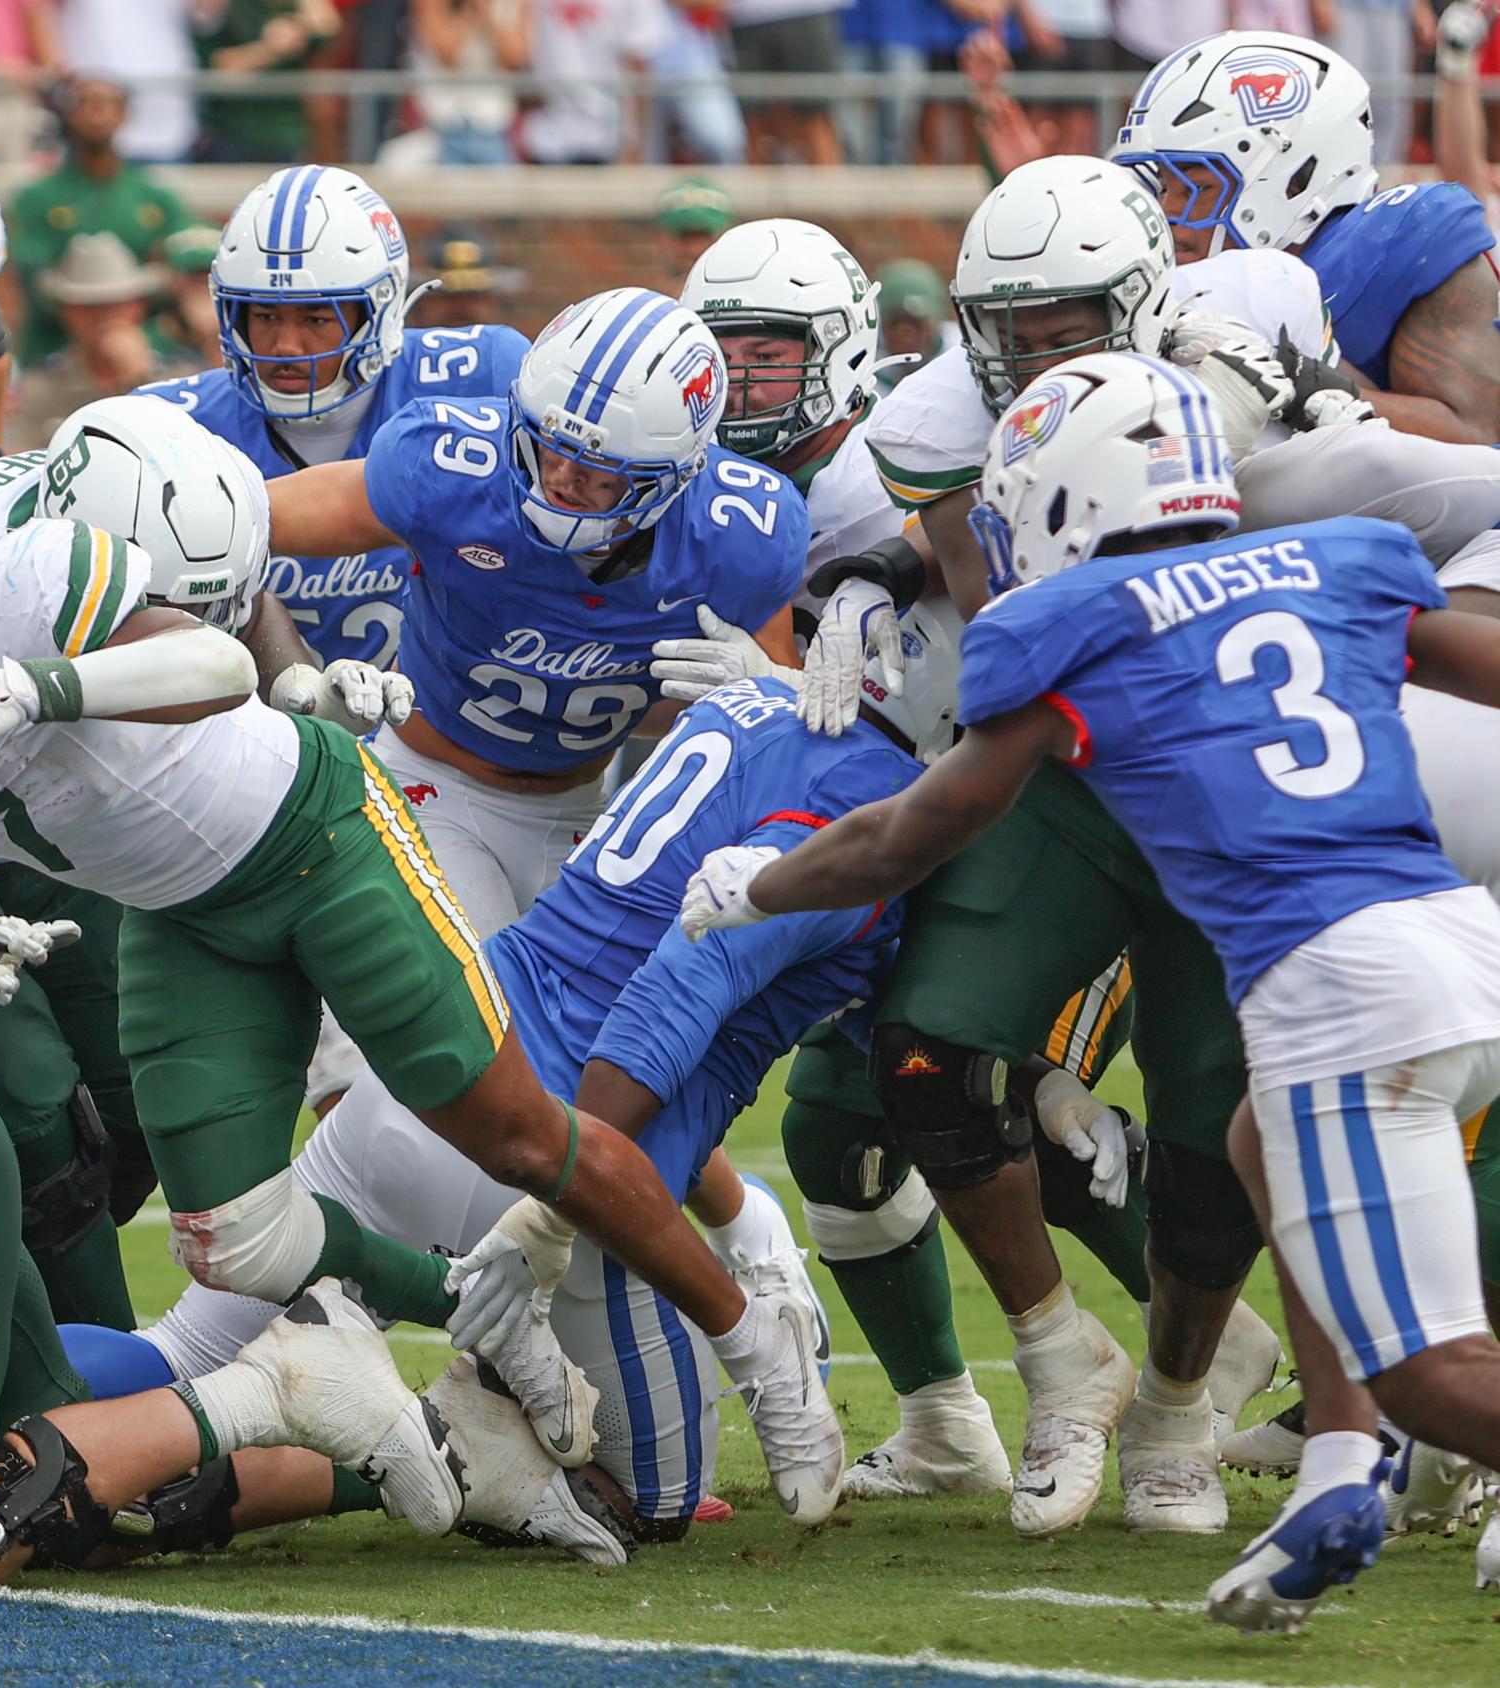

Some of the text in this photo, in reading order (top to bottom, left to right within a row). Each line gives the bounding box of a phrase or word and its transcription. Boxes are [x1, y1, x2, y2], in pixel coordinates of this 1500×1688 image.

[270, 273, 292, 288] 214
[419, 324, 484, 383] 52
[433, 402, 501, 478] 29
[564, 419, 583, 435] 214
[710, 460, 781, 537] 29
[266, 553, 404, 600] Dallas
[464, 550, 502, 567] ACC
[189, 579, 228, 595] BAYLOR
[1125, 540, 1321, 634] MOSES
[491, 628, 646, 681] Dallas
[459, 663, 649, 751] 29
[1216, 611, 1366, 798] 3
